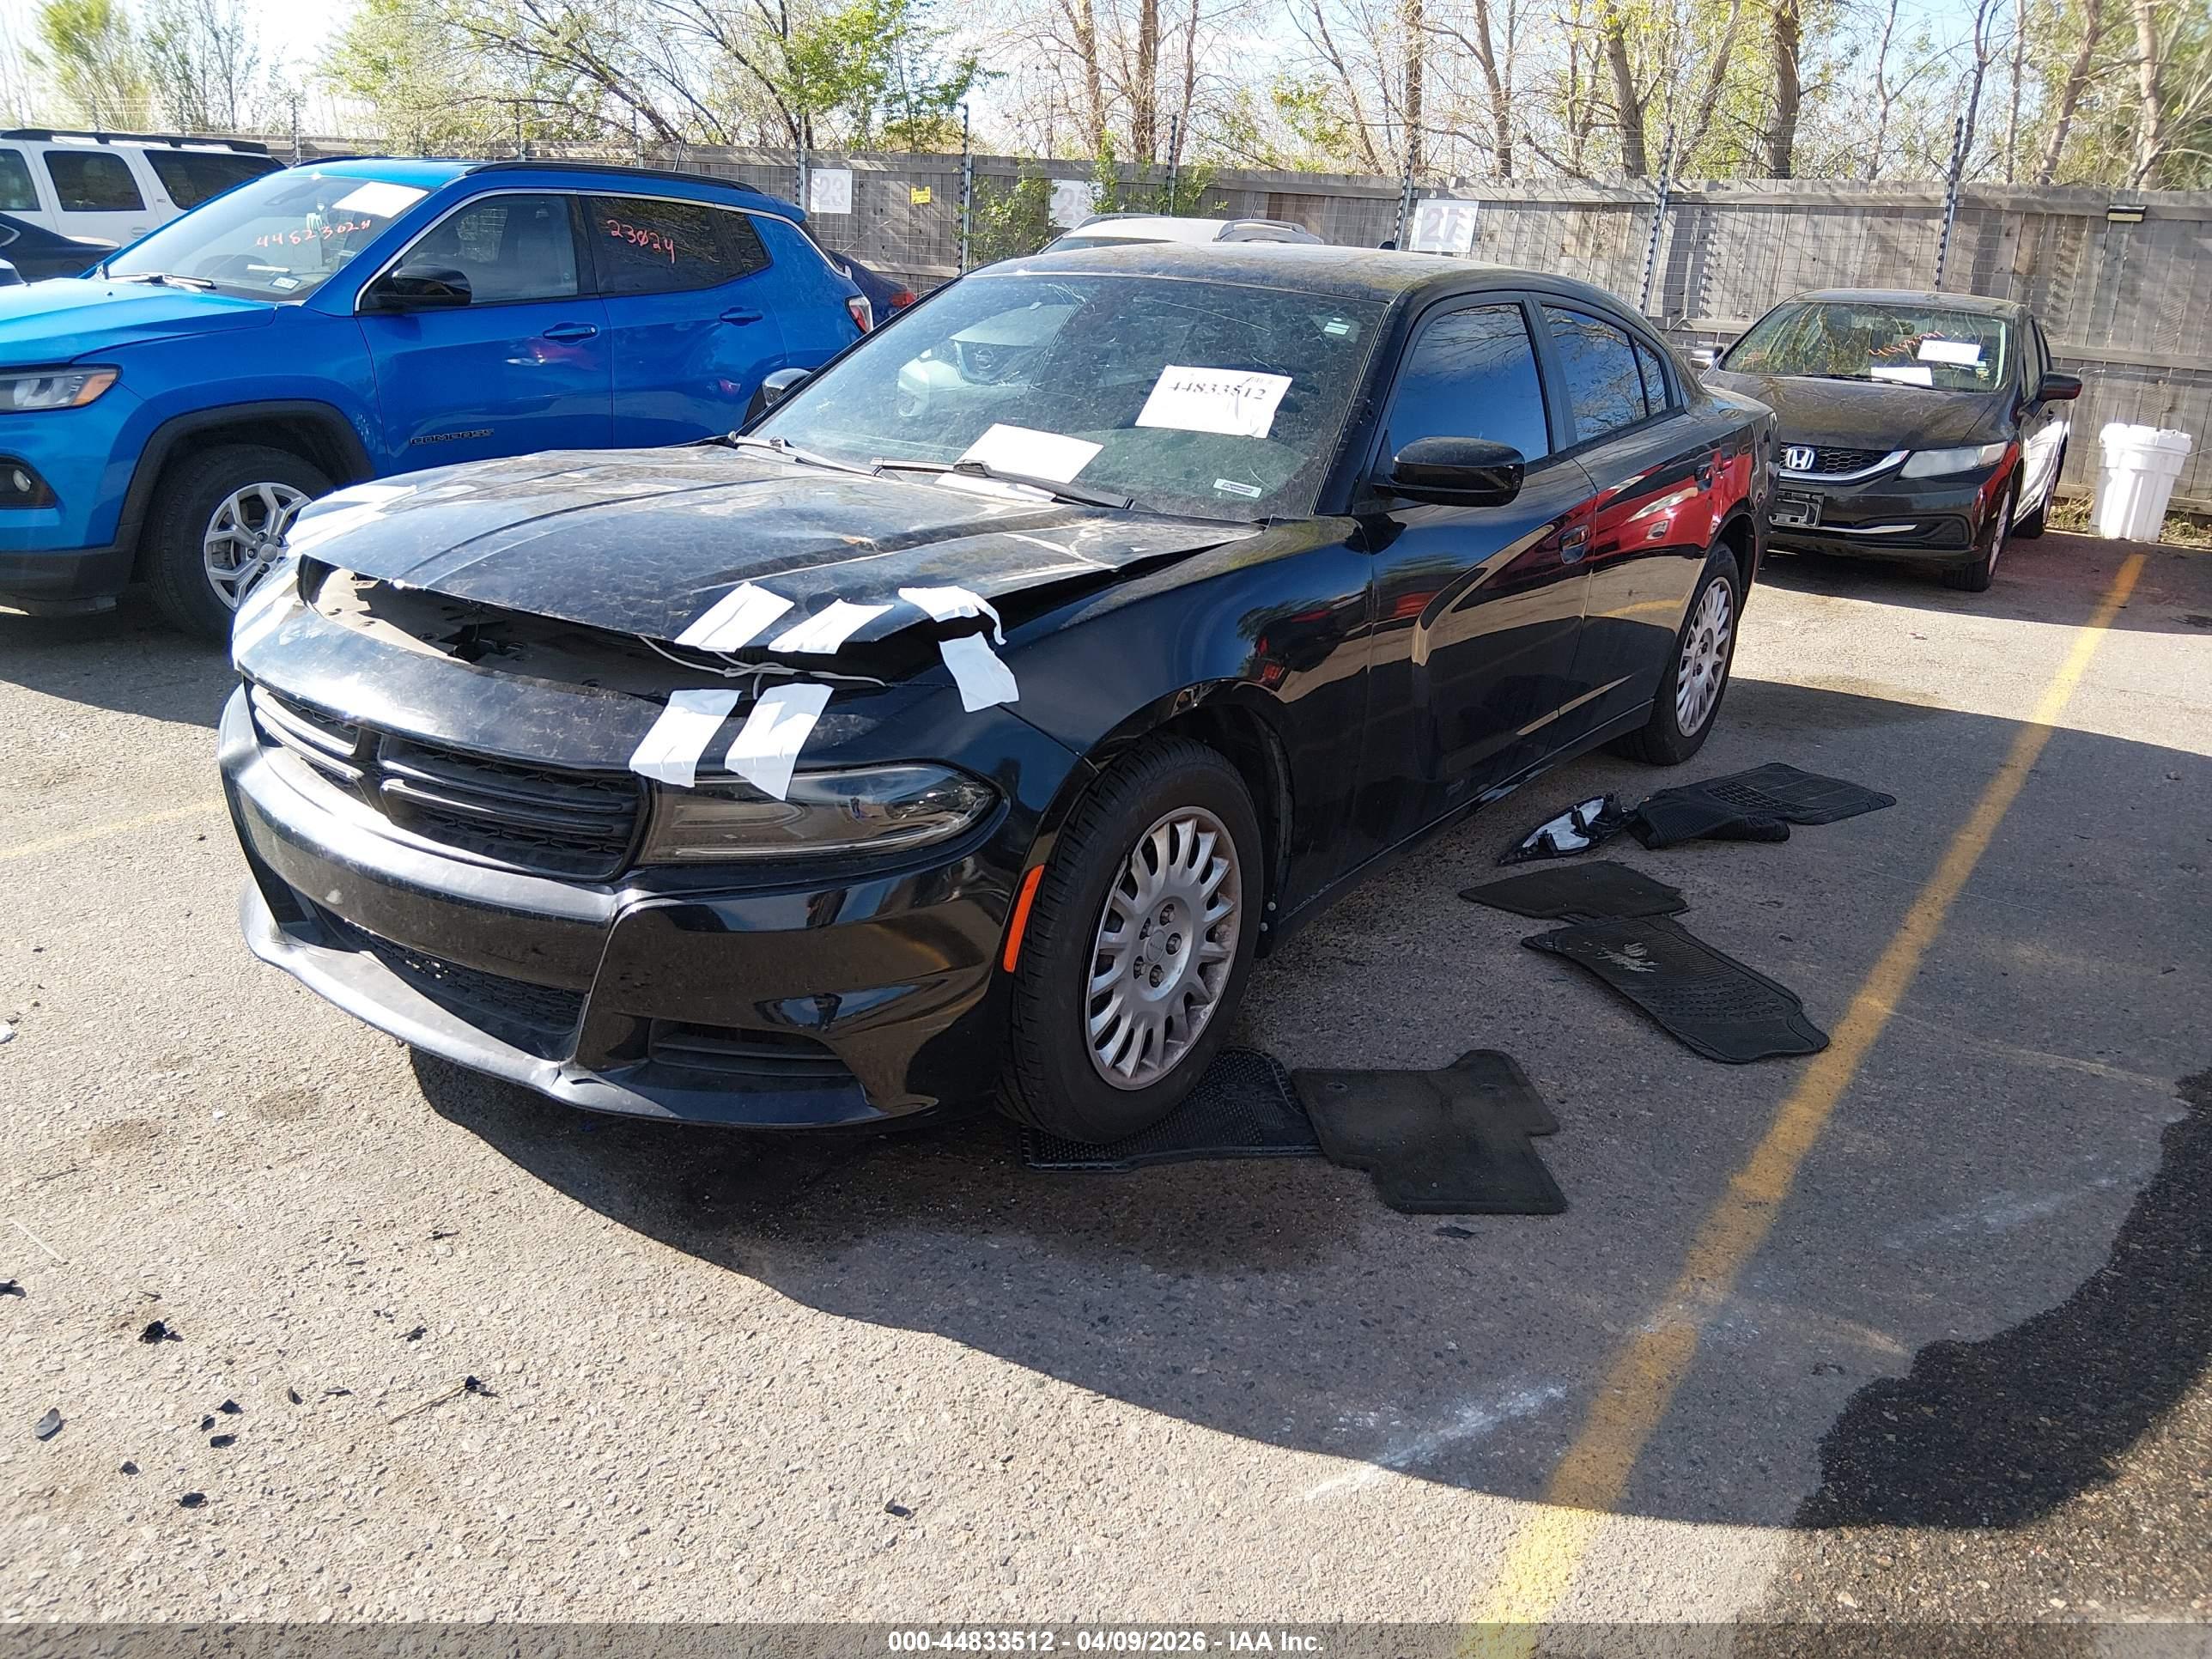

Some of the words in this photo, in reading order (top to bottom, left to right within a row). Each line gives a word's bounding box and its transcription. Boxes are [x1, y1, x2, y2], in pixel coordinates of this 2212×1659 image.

[818, 176, 846, 206] 23
[1421, 207, 1465, 242] 27
[606, 219, 675, 264] 23024
[1169, 380, 1267, 400] 44833512
[410, 428, 495, 446] COMPASS
